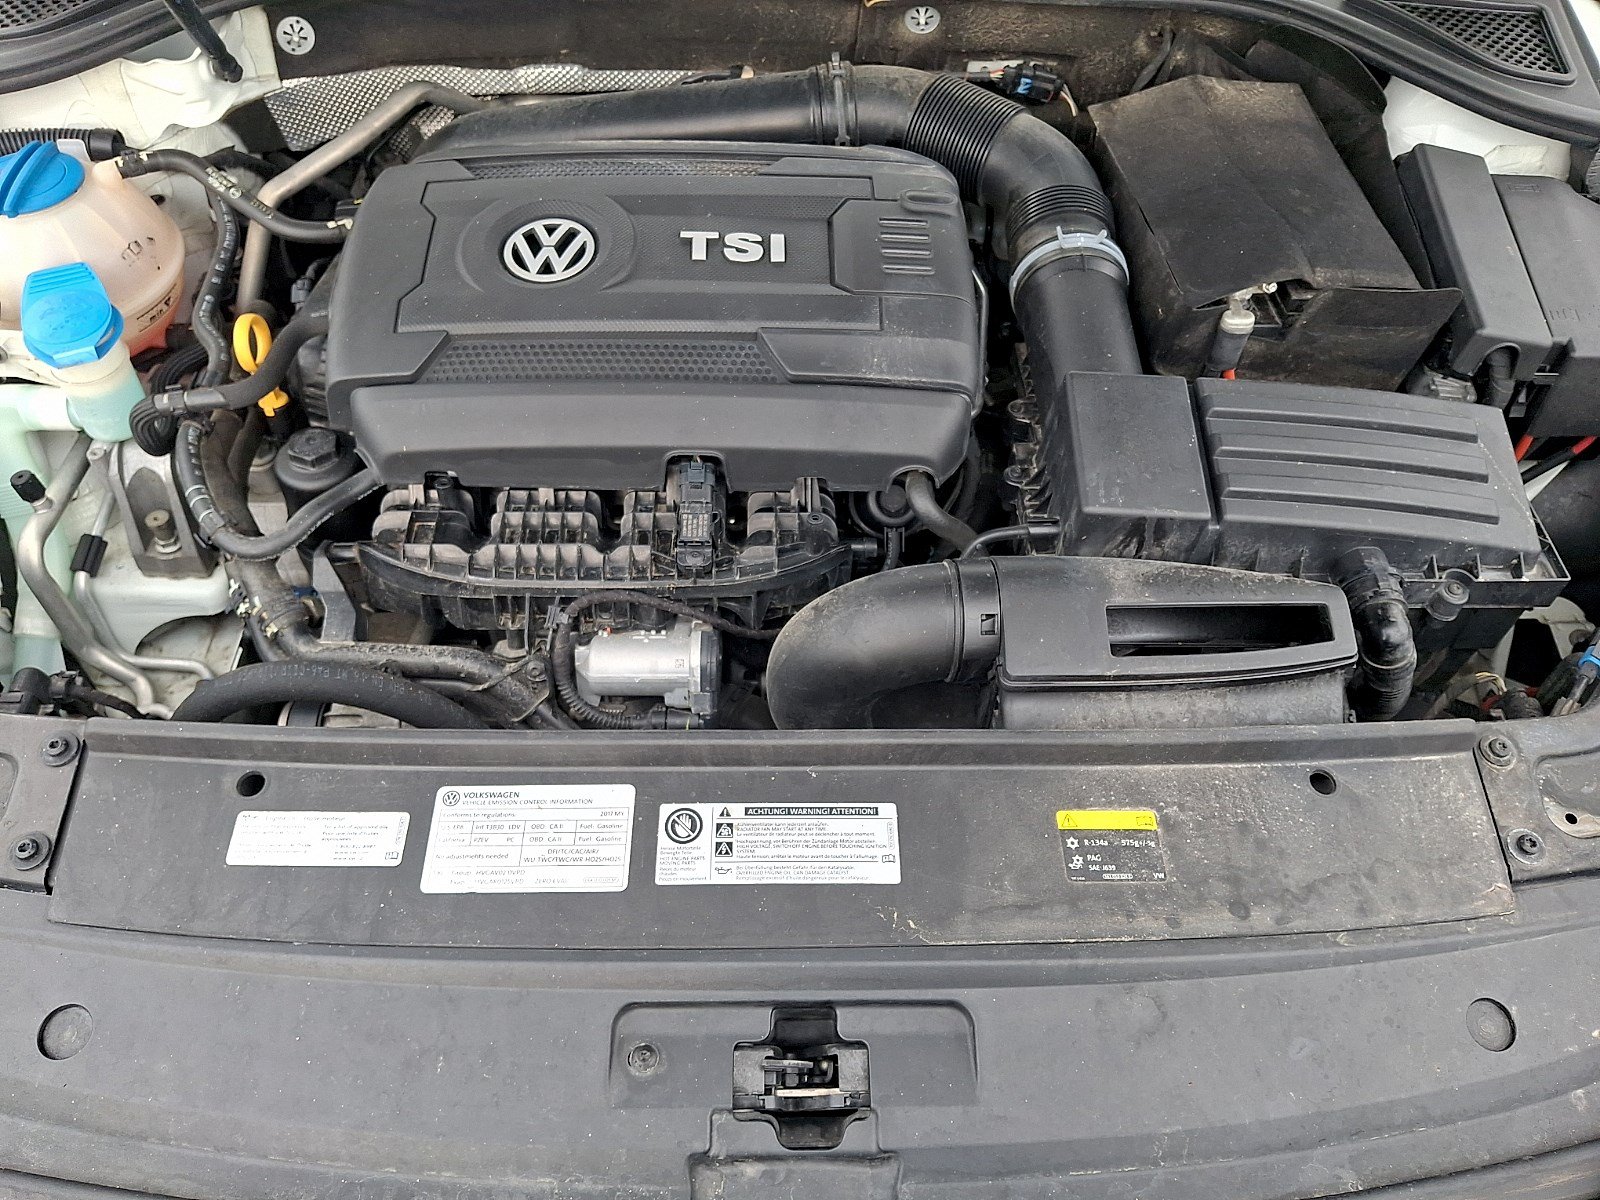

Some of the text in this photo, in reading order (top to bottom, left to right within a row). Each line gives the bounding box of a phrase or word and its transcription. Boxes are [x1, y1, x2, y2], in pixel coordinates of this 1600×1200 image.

[679, 231, 786, 263] TSI
[463, 791, 520, 799] VOLKSWAGEN
[1086, 854, 1102, 862] PAG
